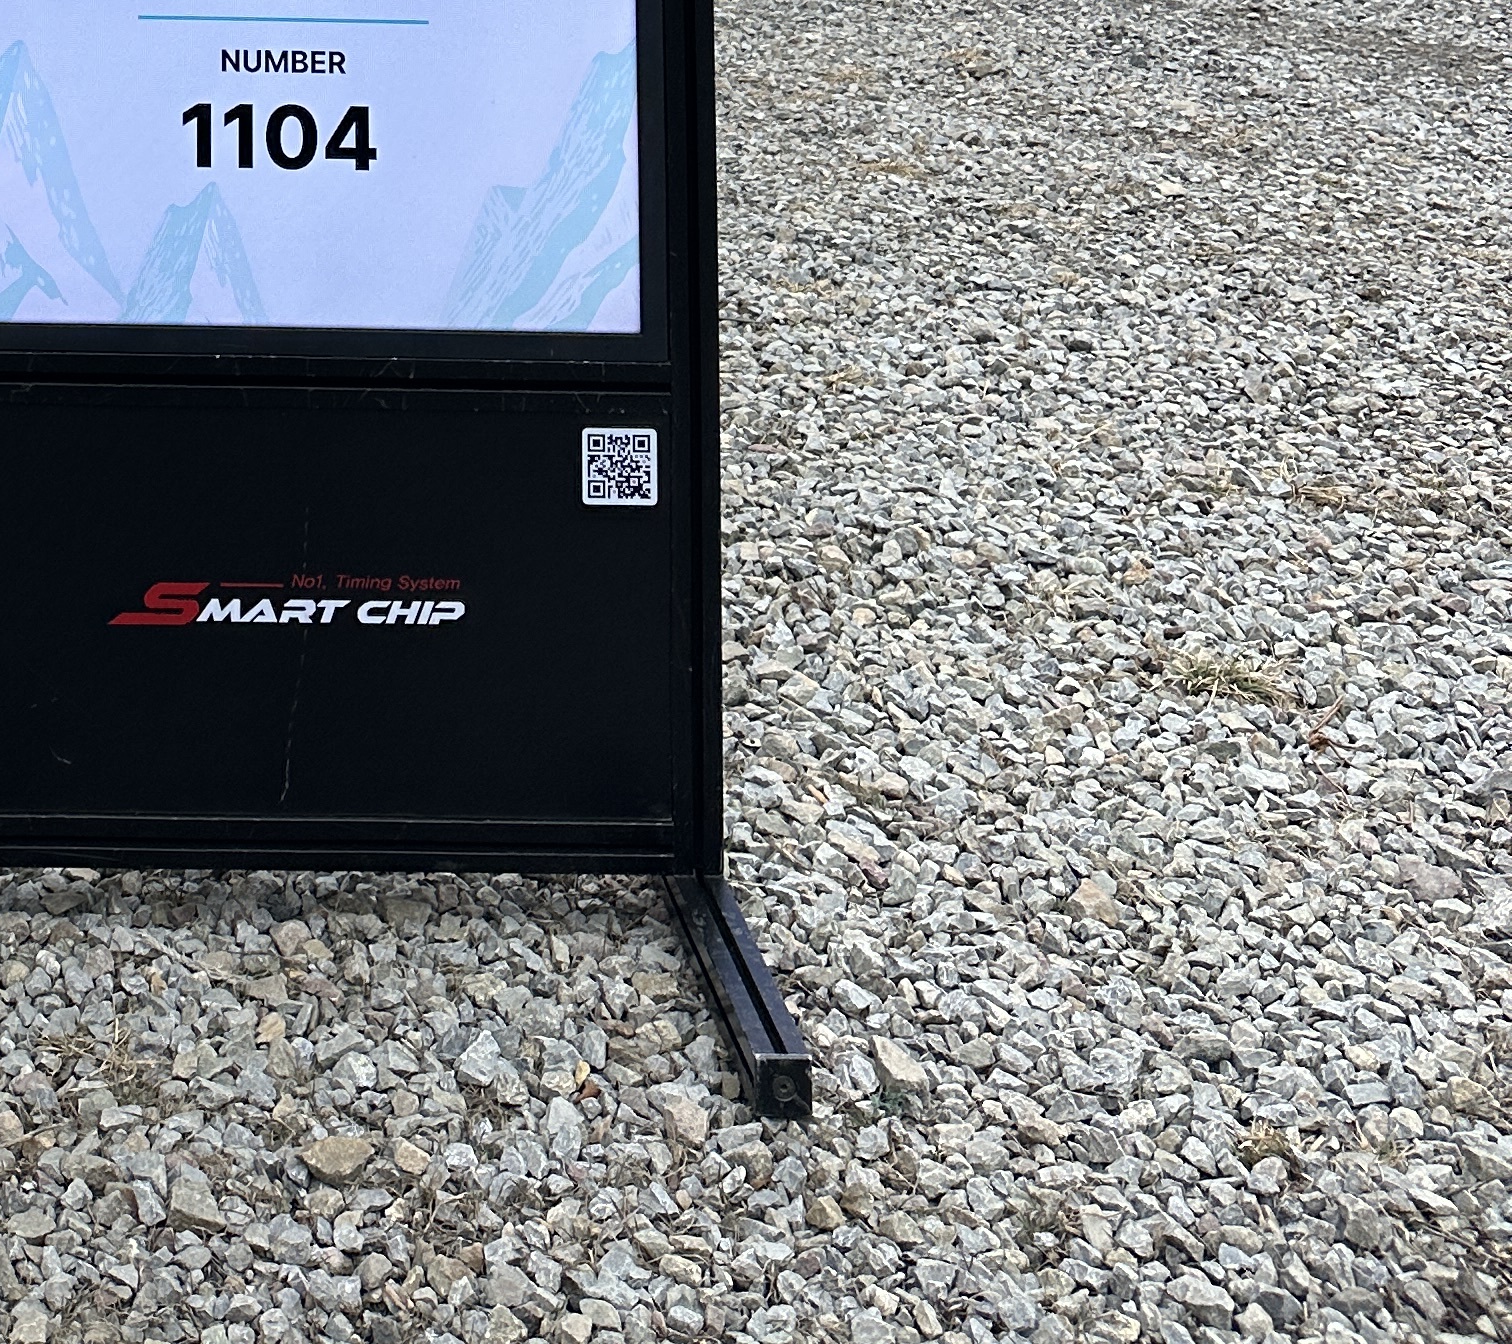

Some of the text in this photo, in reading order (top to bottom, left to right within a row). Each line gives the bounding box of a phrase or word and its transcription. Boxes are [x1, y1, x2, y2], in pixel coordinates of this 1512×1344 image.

[220, 50, 346, 75] NUMBER
[181, 103, 377, 171] 1104
[336, 574, 392, 592] Timing
[397, 575, 460, 592] System
[107, 582, 466, 626] SMART CHIP
